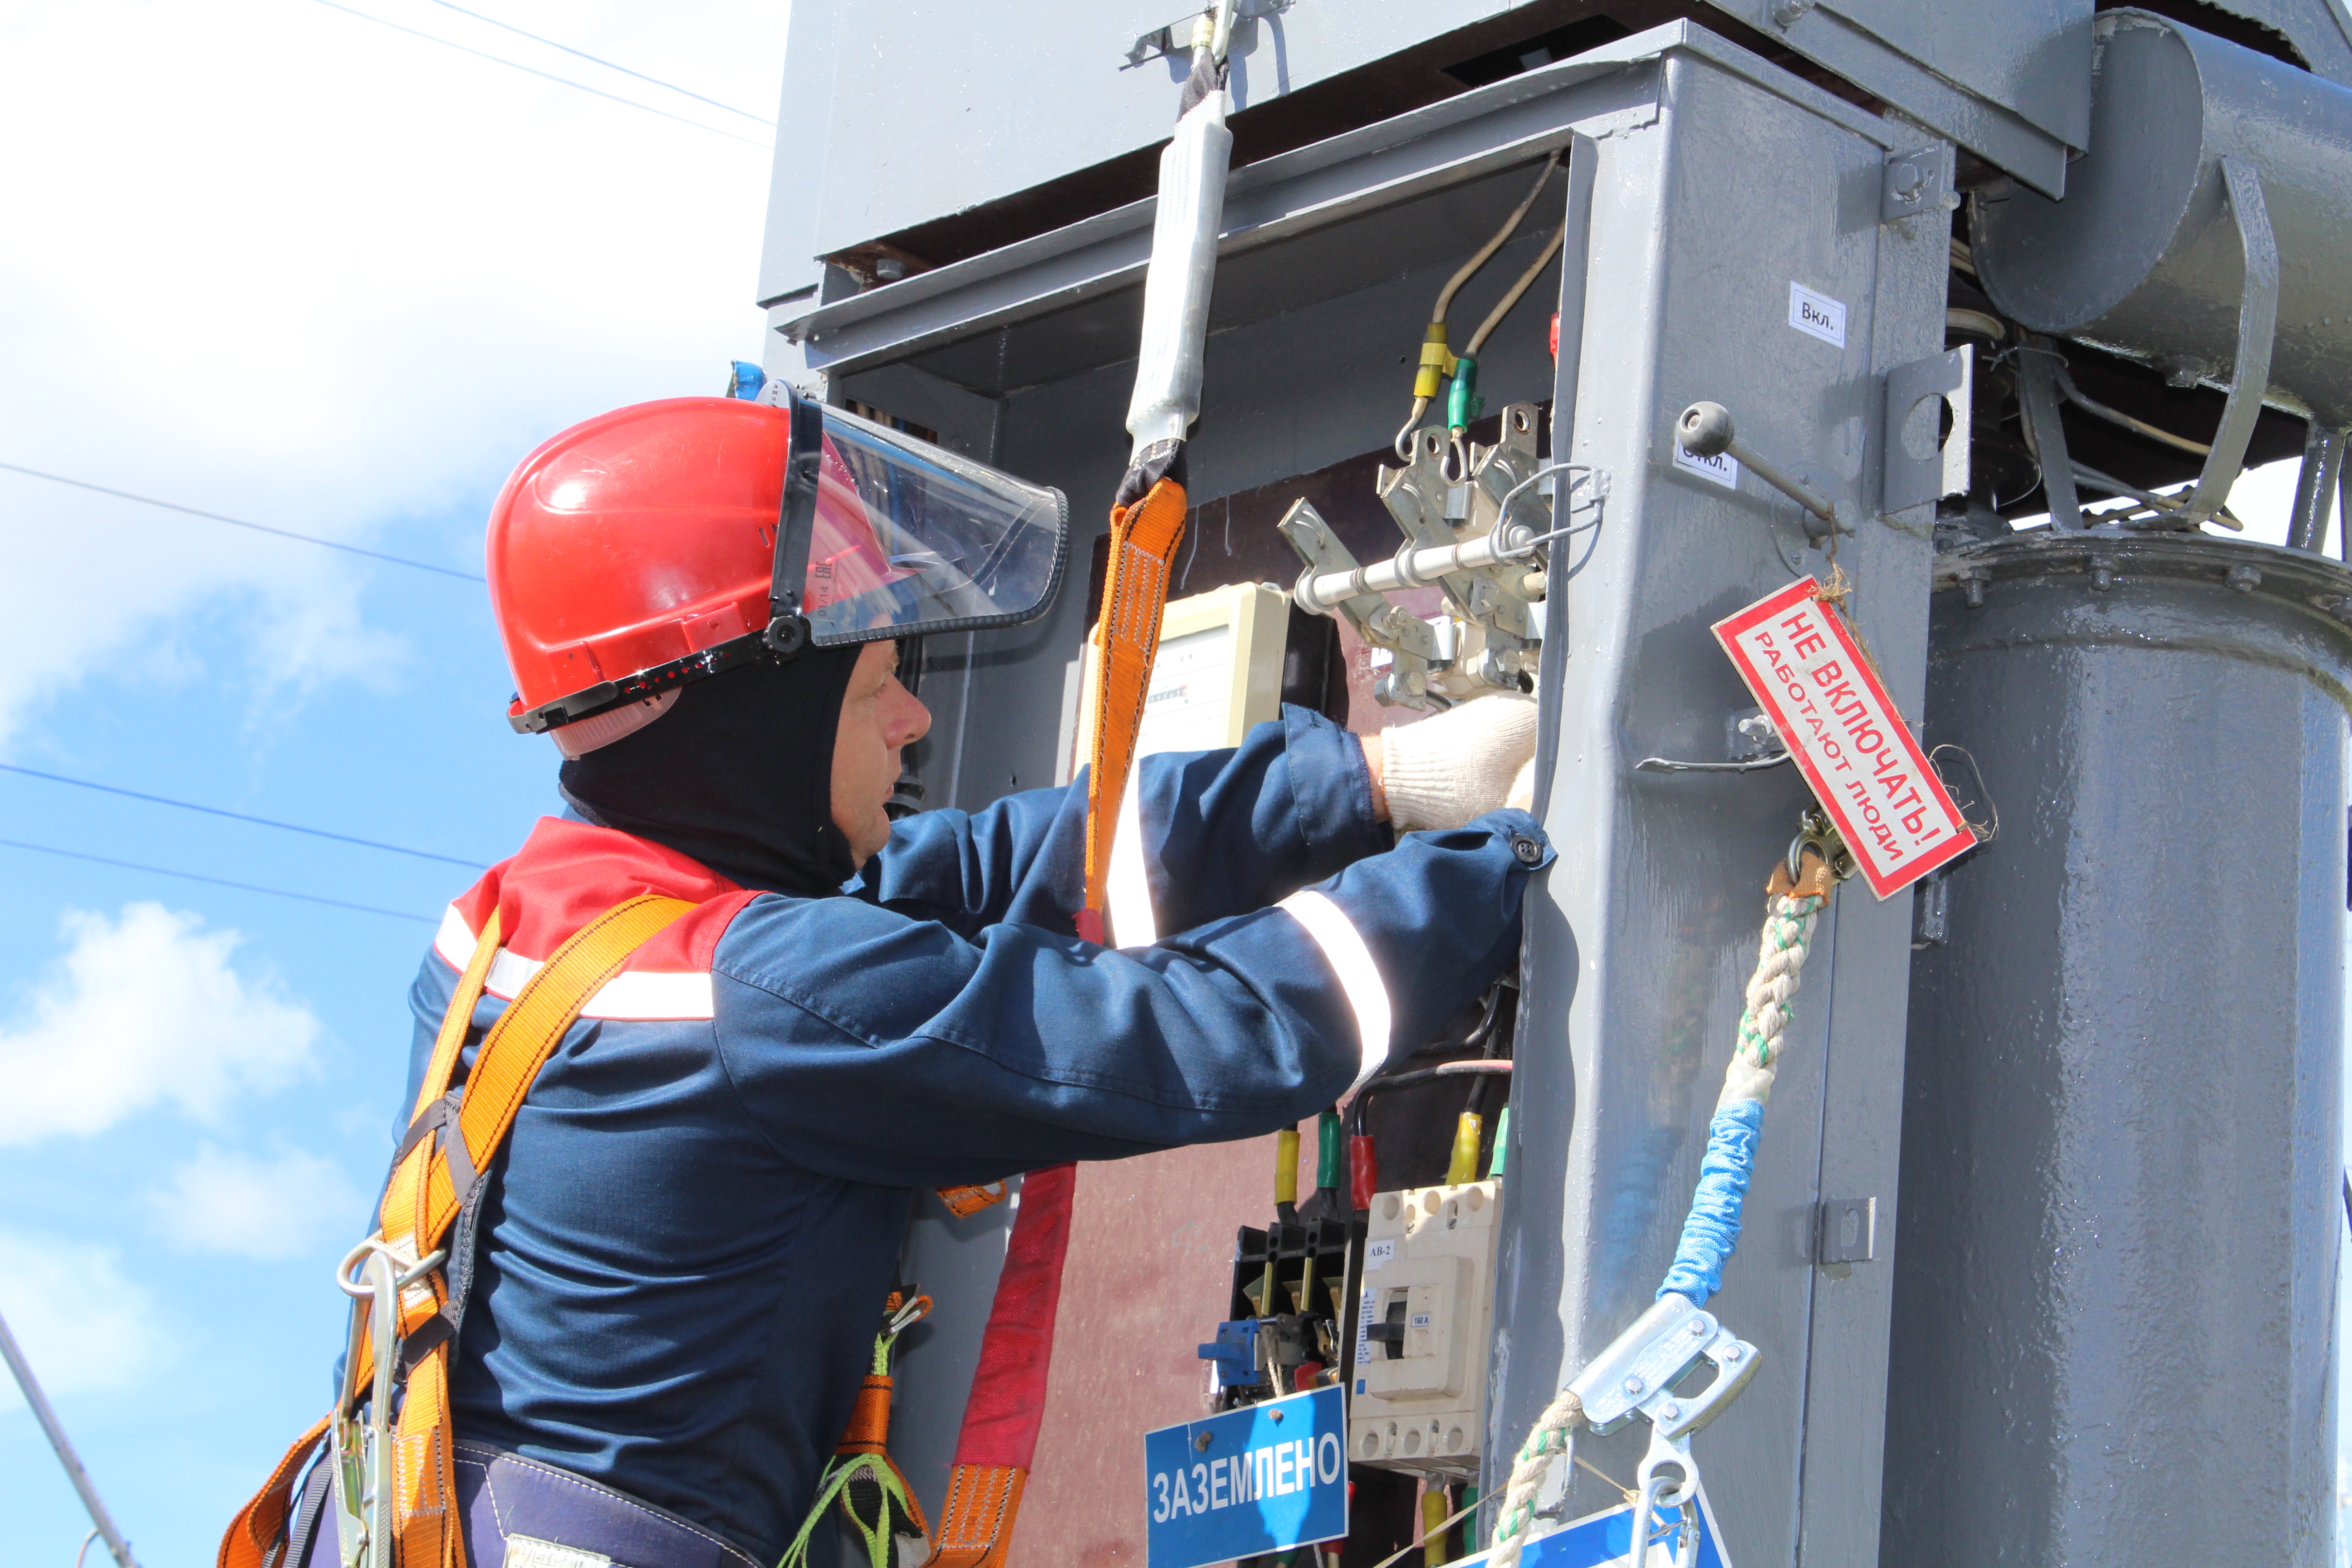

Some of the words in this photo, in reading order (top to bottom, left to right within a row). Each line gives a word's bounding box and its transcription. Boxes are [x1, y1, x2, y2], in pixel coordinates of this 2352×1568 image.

[1802, 301, 1834, 331] Вкл.
[1754, 632, 1852, 771] РАБОТАЮТ
[1846, 780, 1904, 862] ЛЮДИ
[1780, 612, 1827, 660] НЕ
[1811, 660, 1941, 847] ВКЛЮЧАТЬ!
[1370, 1246, 1390, 1256] АВ-2
[1153, 1432, 1340, 1523] ЗАЗЕМЛЕНО
